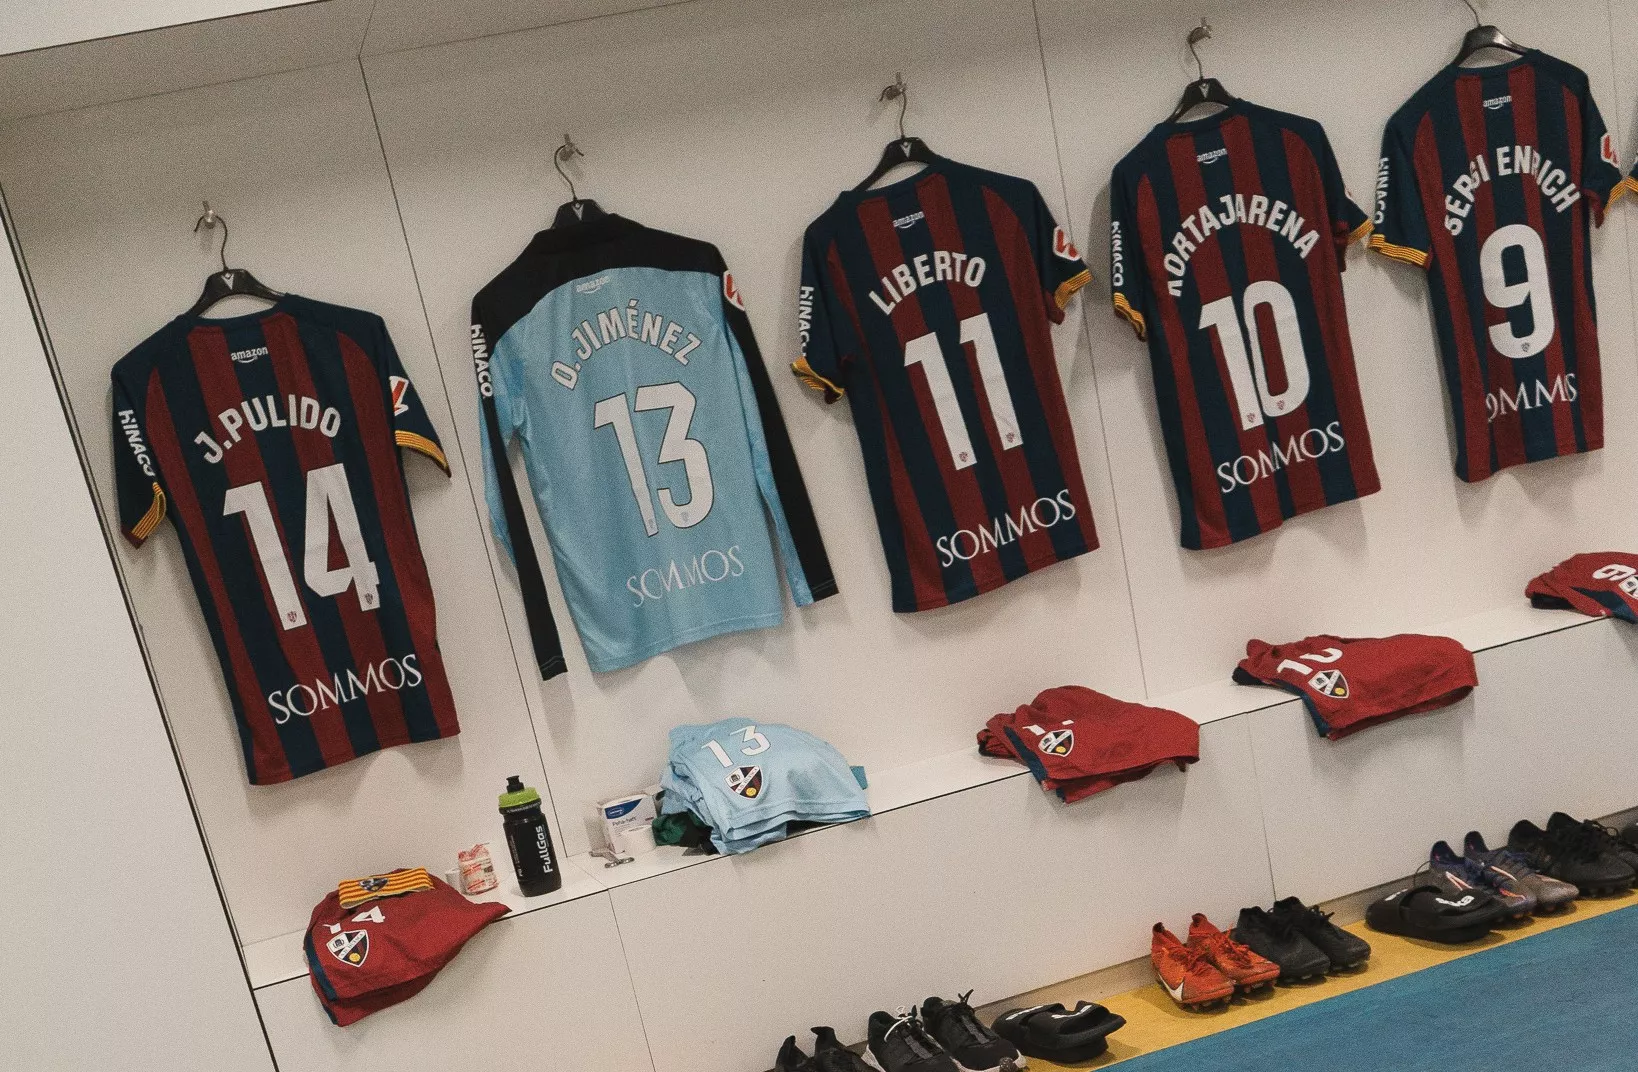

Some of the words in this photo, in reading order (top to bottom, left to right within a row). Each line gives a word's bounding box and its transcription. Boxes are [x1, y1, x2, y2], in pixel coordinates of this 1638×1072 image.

[1483, 95, 1512, 107] amazon
[1196, 148, 1228, 162] amazon
[1496, 145, 1581, 213] ENRICH
[892, 211, 925, 227] amazon
[868, 250, 986, 316] LIBERTO
[1480, 223, 1555, 359] 9
[230, 346, 268, 361] amazon
[1198, 280, 1310, 431] 10
[904, 312, 1023, 471] 11
[194, 394, 341, 464] J.PULIDO
[594, 381, 715, 538] 13
[1216, 421, 1345, 493] SOMMOS
[222, 463, 381, 631] 14
[936, 488, 1076, 568] SOMMOS
[267, 653, 422, 725] SOMMOS
[1276, 647, 1343, 676] 12
[701, 725, 771, 768] 13
[535, 825, 554, 874] FullGas
